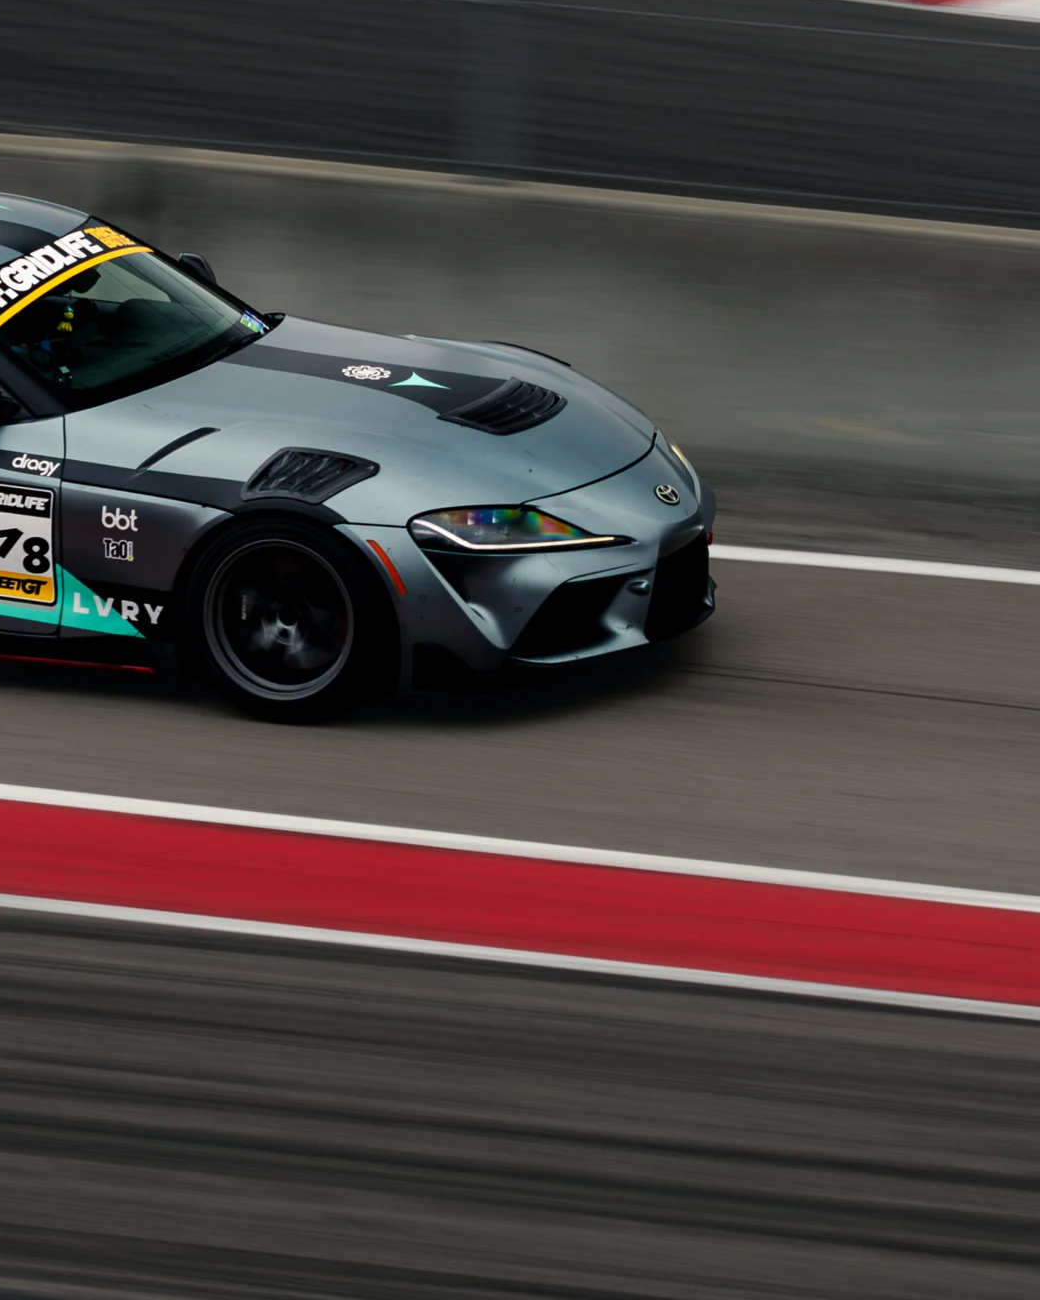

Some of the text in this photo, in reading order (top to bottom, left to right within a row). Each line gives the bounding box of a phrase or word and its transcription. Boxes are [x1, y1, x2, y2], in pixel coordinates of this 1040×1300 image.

[0, 230, 104, 292] GRIDLIFE
[12, 453, 60, 477] dragy
[101, 505, 139, 532] bbt
[73, 592, 164, 625] LVRY
